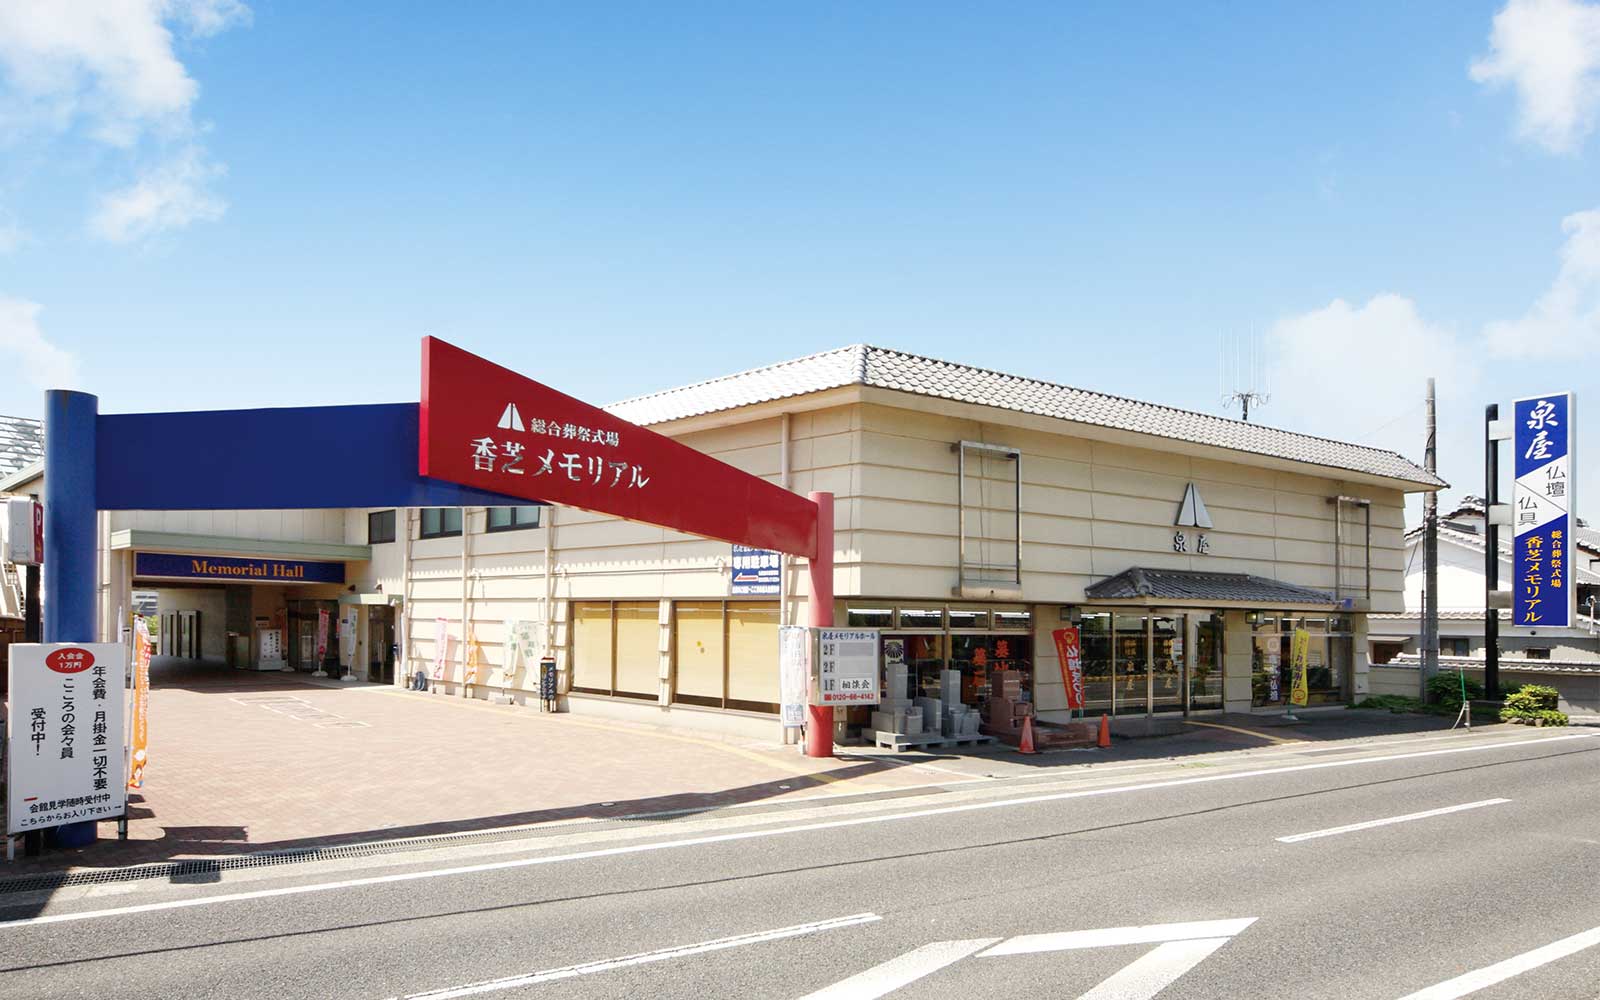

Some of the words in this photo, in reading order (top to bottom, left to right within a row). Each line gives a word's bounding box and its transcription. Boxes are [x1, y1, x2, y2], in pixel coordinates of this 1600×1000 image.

[530, 416, 620, 448] 総合葬祭式場
[1524, 400, 1559, 460] 泉屋
[1545, 465, 1566, 498] 仏壇
[1517, 495, 1538, 527] 仏具
[191, 558, 268, 577] Memorial
[272, 560, 304, 578] Hall
[1550, 529, 1563, 589] 総合葬祭式場
[1523, 535, 1544, 623] 香芝メモリアル
[57, 652, 85, 661] 入会金
[823, 643, 835, 656] 2F
[823, 661, 835, 673] 2F
[823, 679, 835, 691] 1F
[841, 679, 870, 689] 相談会
[59, 677, 76, 760] こころの会々員
[20, 805, 112, 827] こちらからお入り下さい
[29, 792, 111, 814] 会館見学随時受付中
